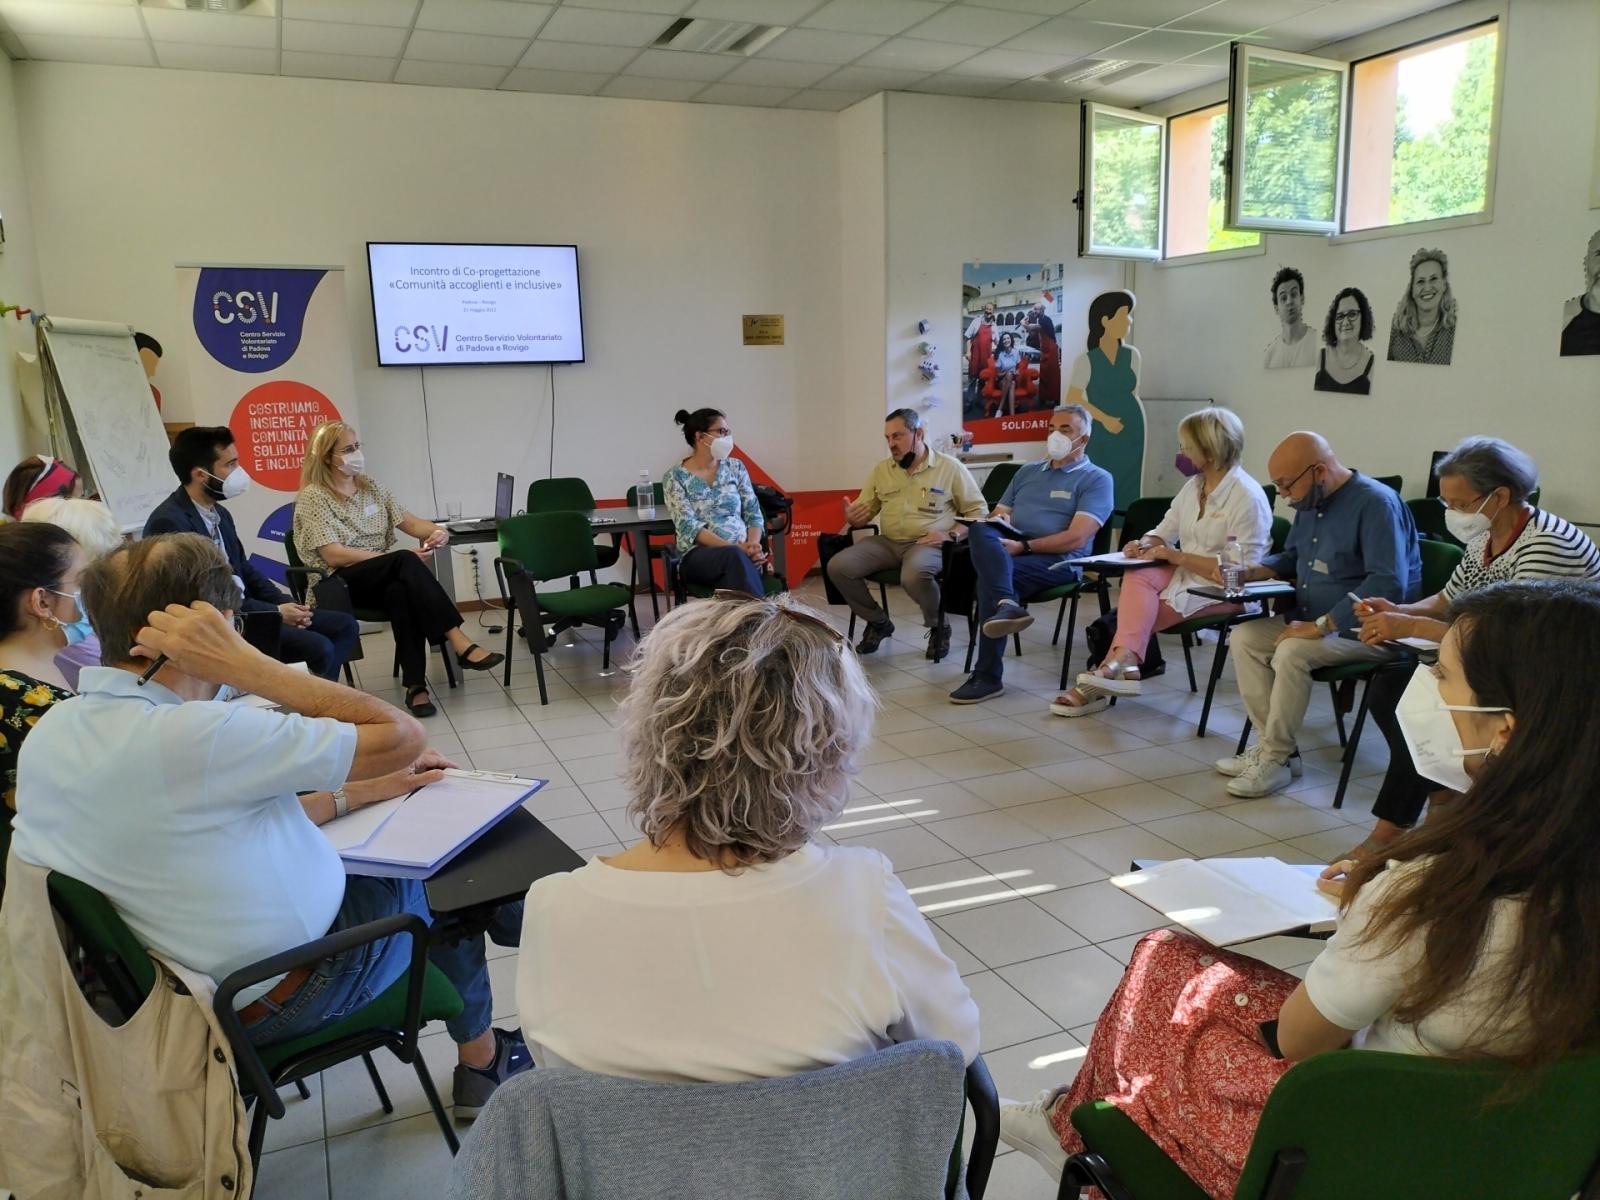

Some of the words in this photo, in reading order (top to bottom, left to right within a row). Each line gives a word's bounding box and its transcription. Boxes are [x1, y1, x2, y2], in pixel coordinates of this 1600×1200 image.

[410, 266, 450, 276] Incontro
[452, 267, 461, 276] di
[463, 267, 541, 278] Co-progettazione
[389, 279, 446, 290] «Comunità
[449, 280, 503, 292] accoglienti
[505, 282, 512, 290] e
[514, 280, 562, 290] inclusive»
[212, 291, 278, 324] CSV
[395, 325, 448, 352] CSV
[455, 334, 483, 342] Centro
[516, 333, 563, 341] Volontariato
[502, 344, 530, 352] Rovigo
[248, 401, 320, 416] COSTRUIAMO
[250, 416, 296, 429] INSIEME
[299, 415, 307, 428] A
[251, 427, 308, 444] COMUNITÀ
[253, 443, 305, 457] SOLIDALI
[254, 459, 264, 472] E
